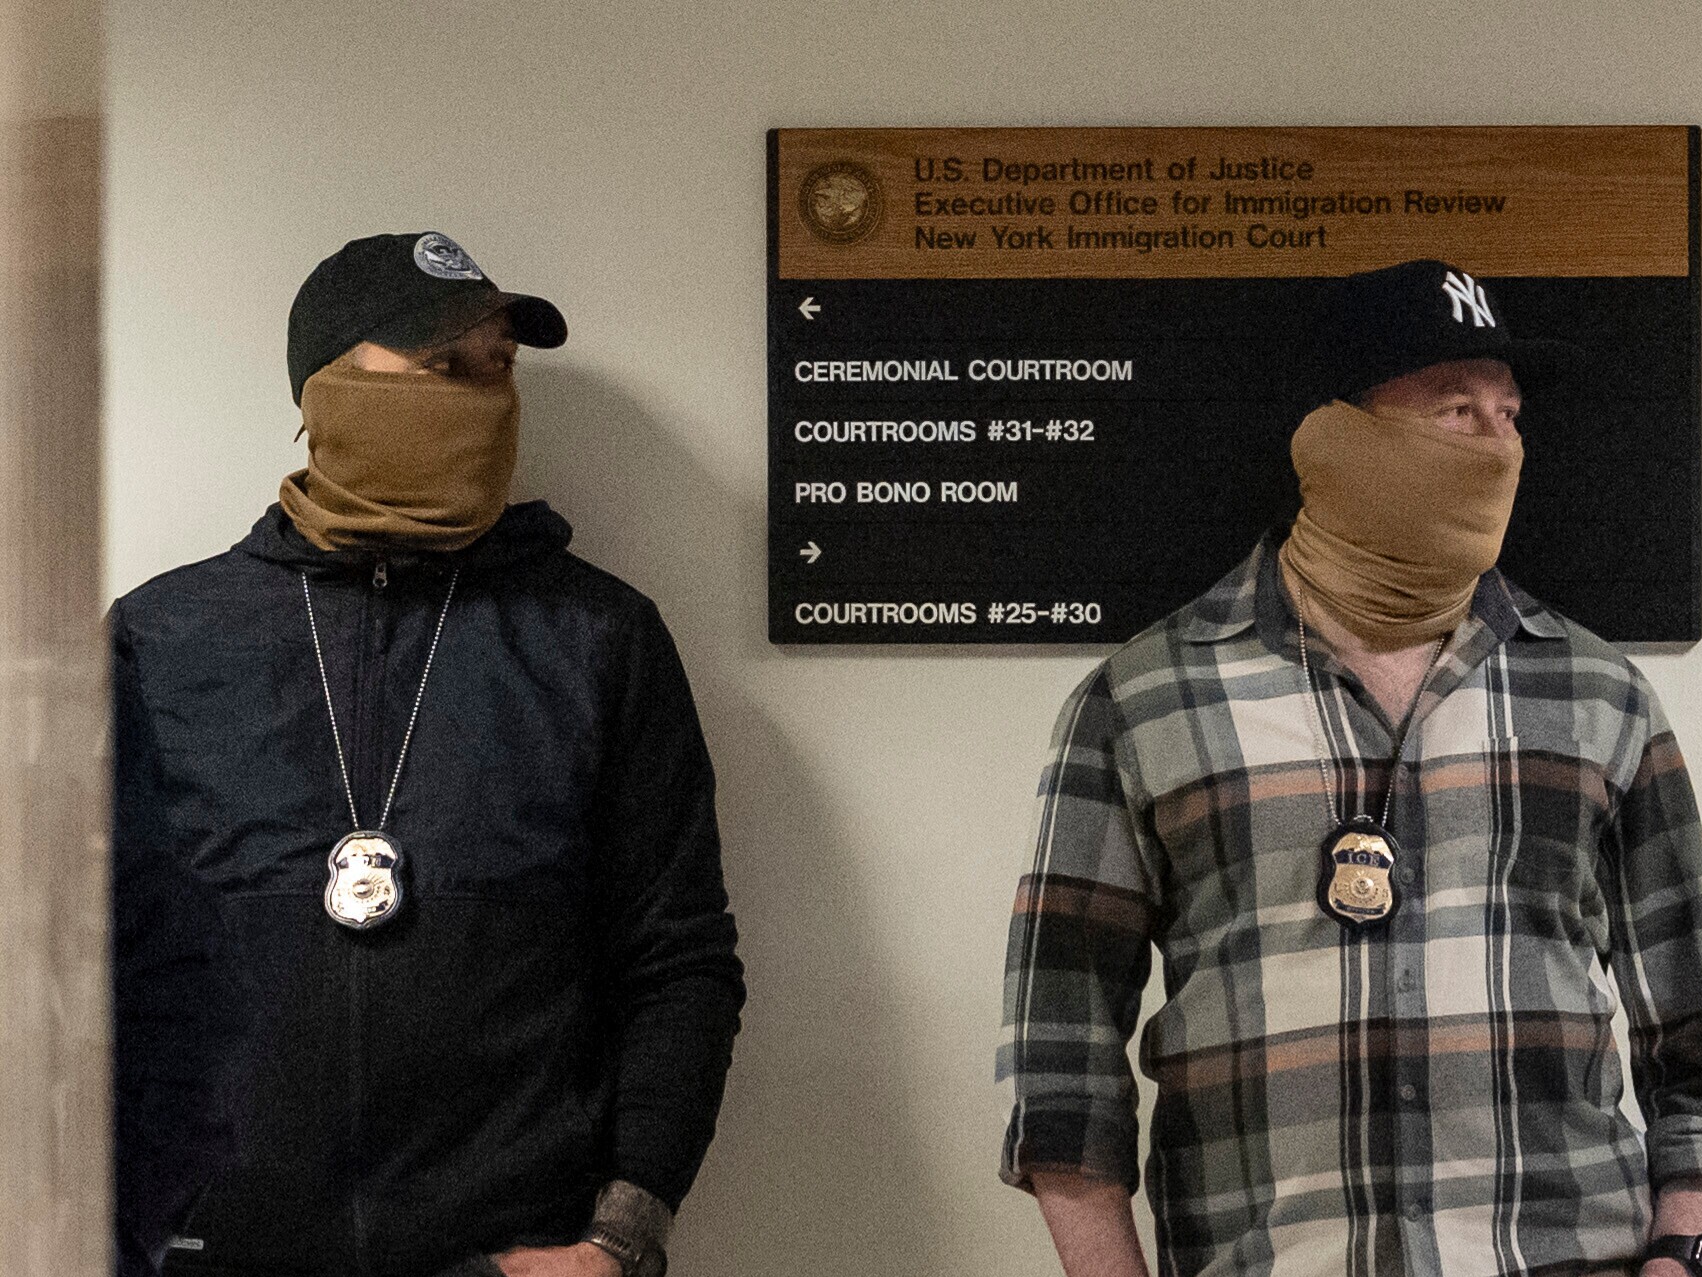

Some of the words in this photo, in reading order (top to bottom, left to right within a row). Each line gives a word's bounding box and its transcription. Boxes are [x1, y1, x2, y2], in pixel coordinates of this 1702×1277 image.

[914, 157, 969, 183] U.S.
[982, 157, 1154, 186] Department
[1167, 156, 1197, 181] of
[1209, 157, 1315, 181] Justice
[915, 191, 1055, 216] Executive
[1068, 190, 1158, 215] Office
[1171, 190, 1211, 215] for
[1224, 190, 1392, 221] Immigration
[1404, 189, 1506, 215] Review
[915, 226, 976, 249] New
[992, 226, 1053, 249] York
[1067, 225, 1234, 254] Immigration
[1246, 223, 1326, 249] Court
[1441, 270, 1496, 328] NY
[794, 359, 959, 383] CEREMONIAL
[968, 359, 1133, 381] COURTROOM
[794, 420, 977, 443] COURTROOMS
[987, 419, 1095, 442] #31-#32
[795, 481, 847, 504] PRO
[856, 481, 931, 504] BONO
[940, 480, 1018, 503] ROOM
[794, 602, 977, 625] COURTROOMS
[987, 602, 1102, 625] #25-#30
